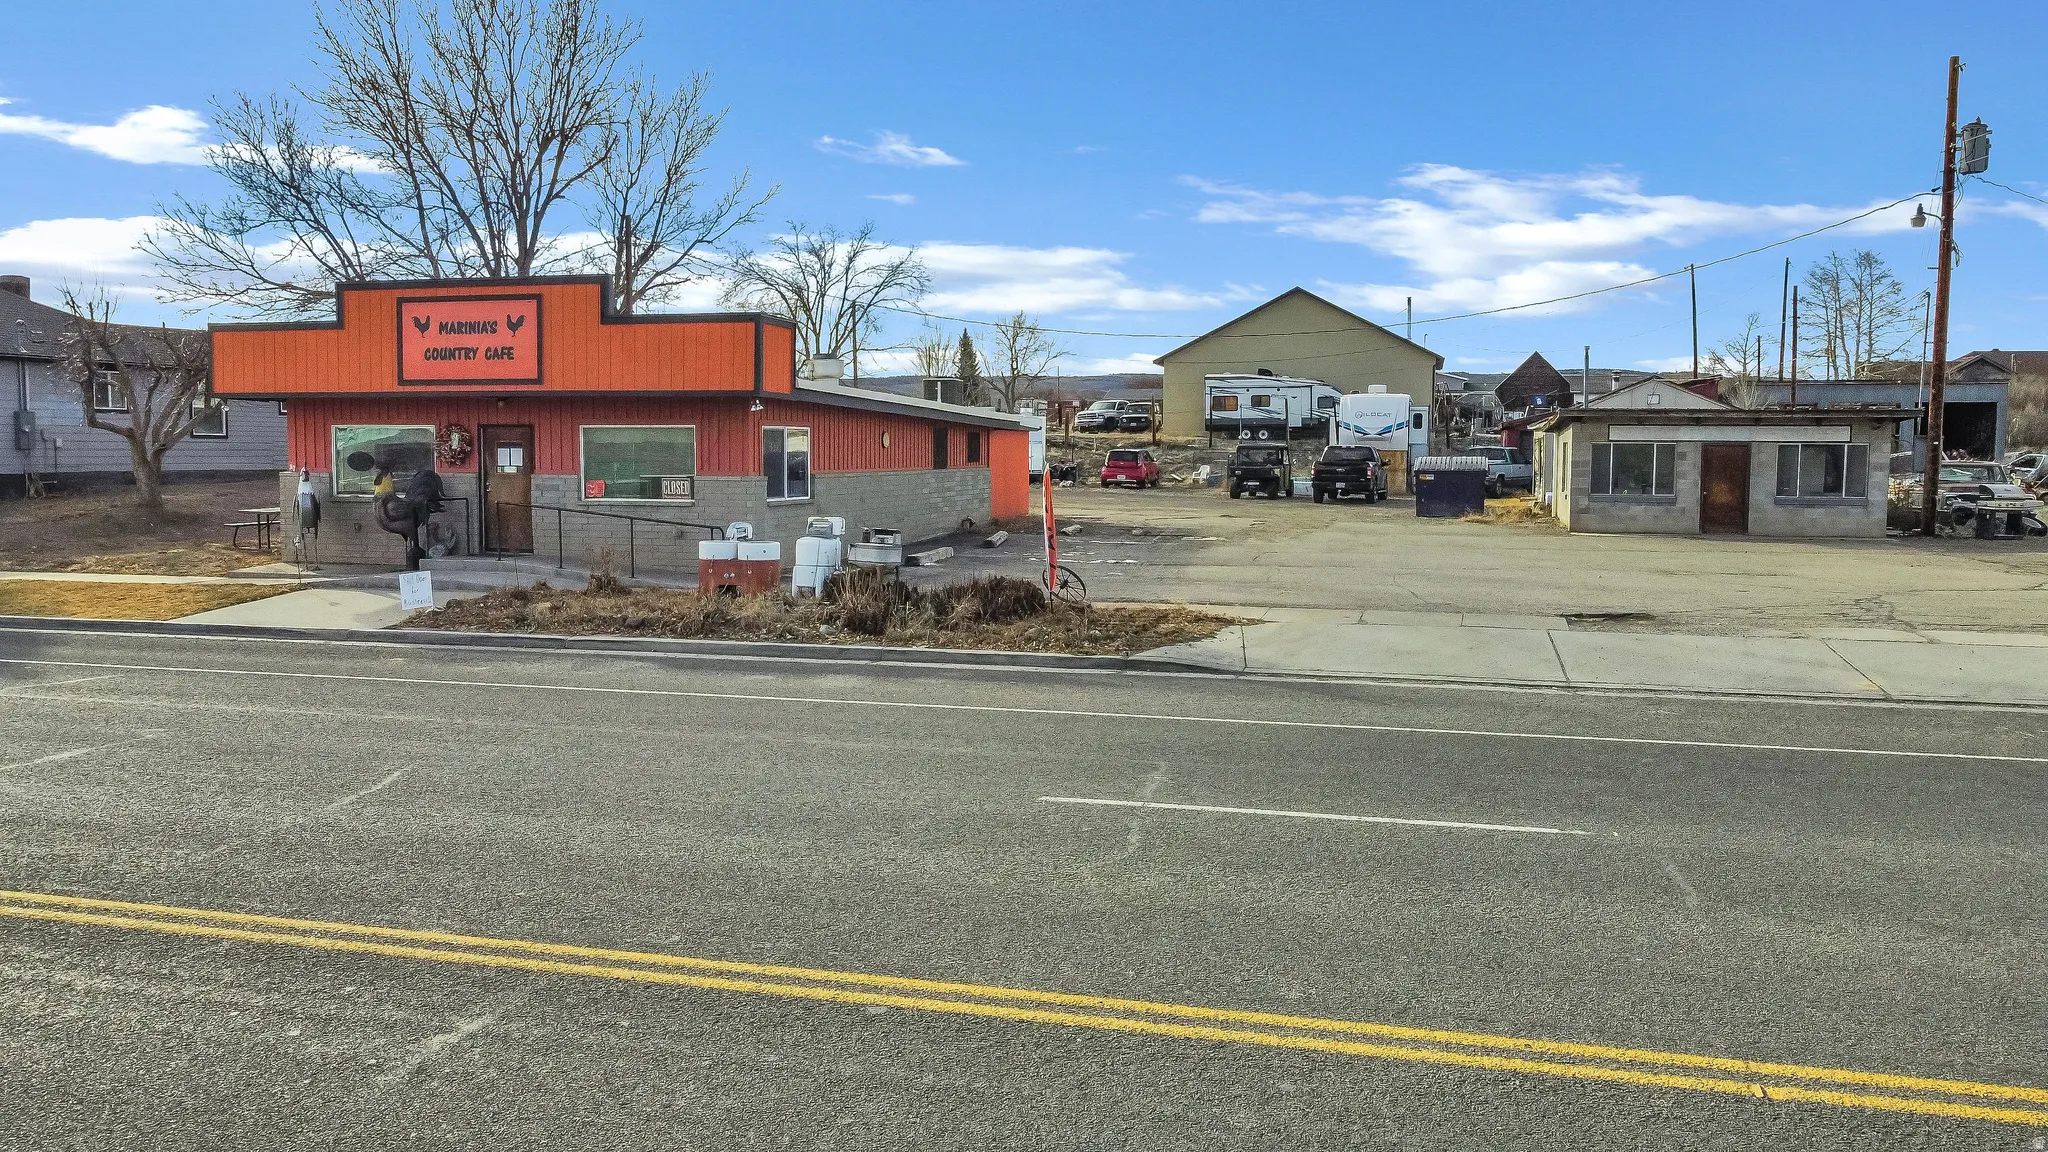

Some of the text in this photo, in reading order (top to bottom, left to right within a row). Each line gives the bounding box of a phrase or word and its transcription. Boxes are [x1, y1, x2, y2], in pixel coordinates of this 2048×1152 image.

[438, 320, 498, 335] MARINIA'S
[424, 346, 515, 361] COUNTRY CAFE
[663, 480, 690, 495] CLOSED
